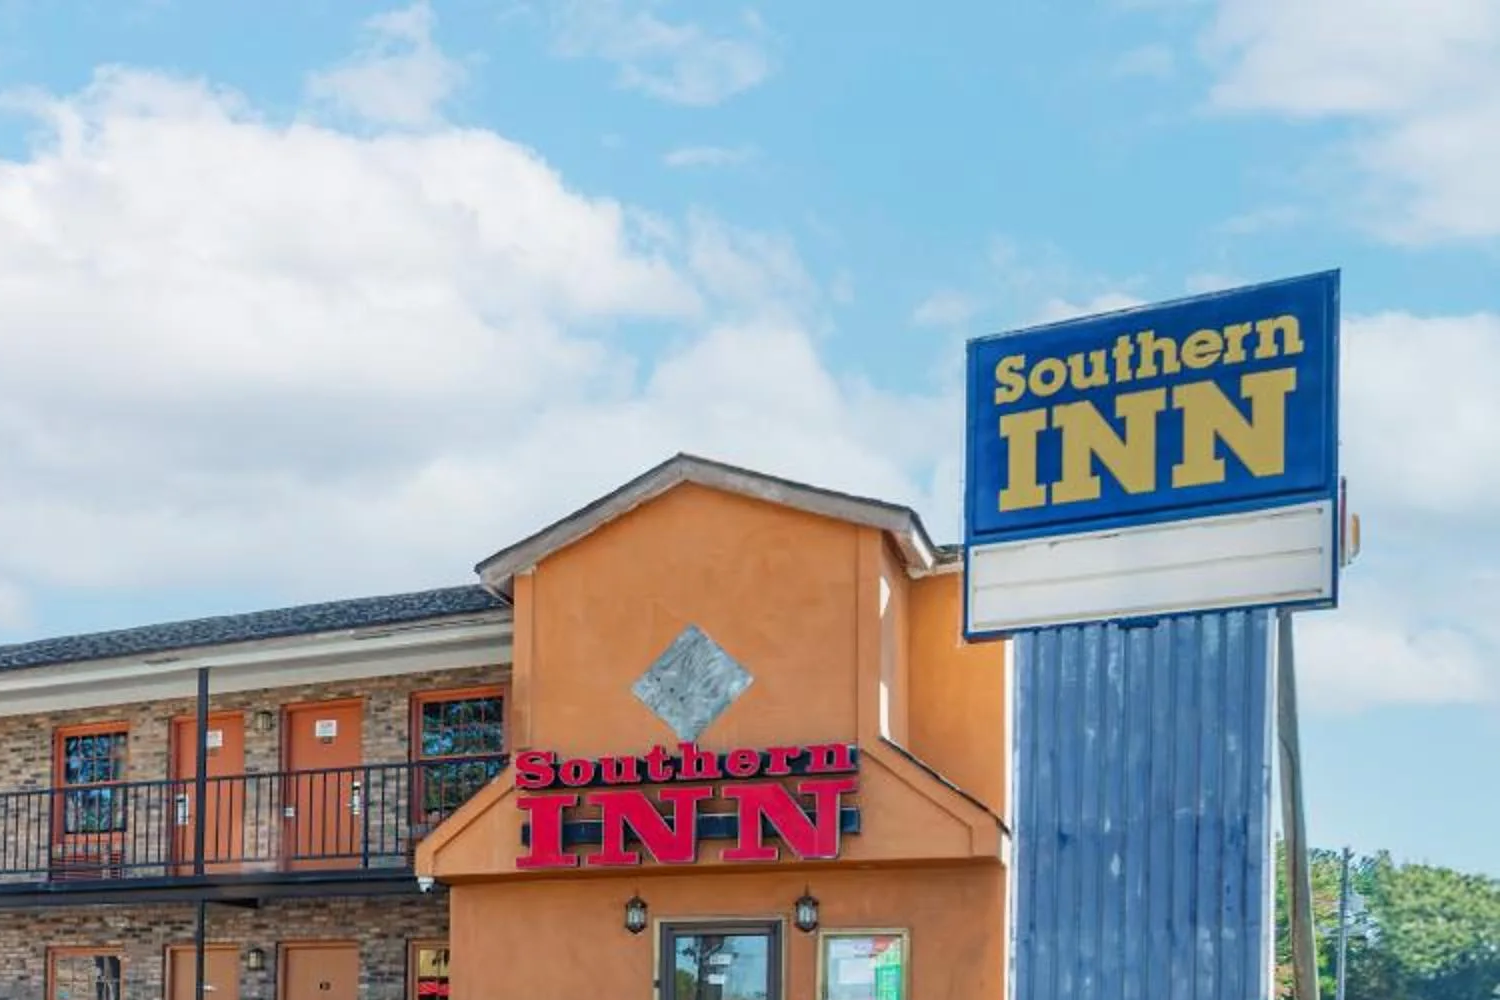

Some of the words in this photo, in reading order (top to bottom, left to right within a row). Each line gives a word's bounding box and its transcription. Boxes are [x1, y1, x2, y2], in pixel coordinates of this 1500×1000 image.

[994, 314, 1304, 405] Southern
[998, 367, 1297, 513] INN
[514, 741, 855, 790] Southern
[515, 778, 860, 870] INN
